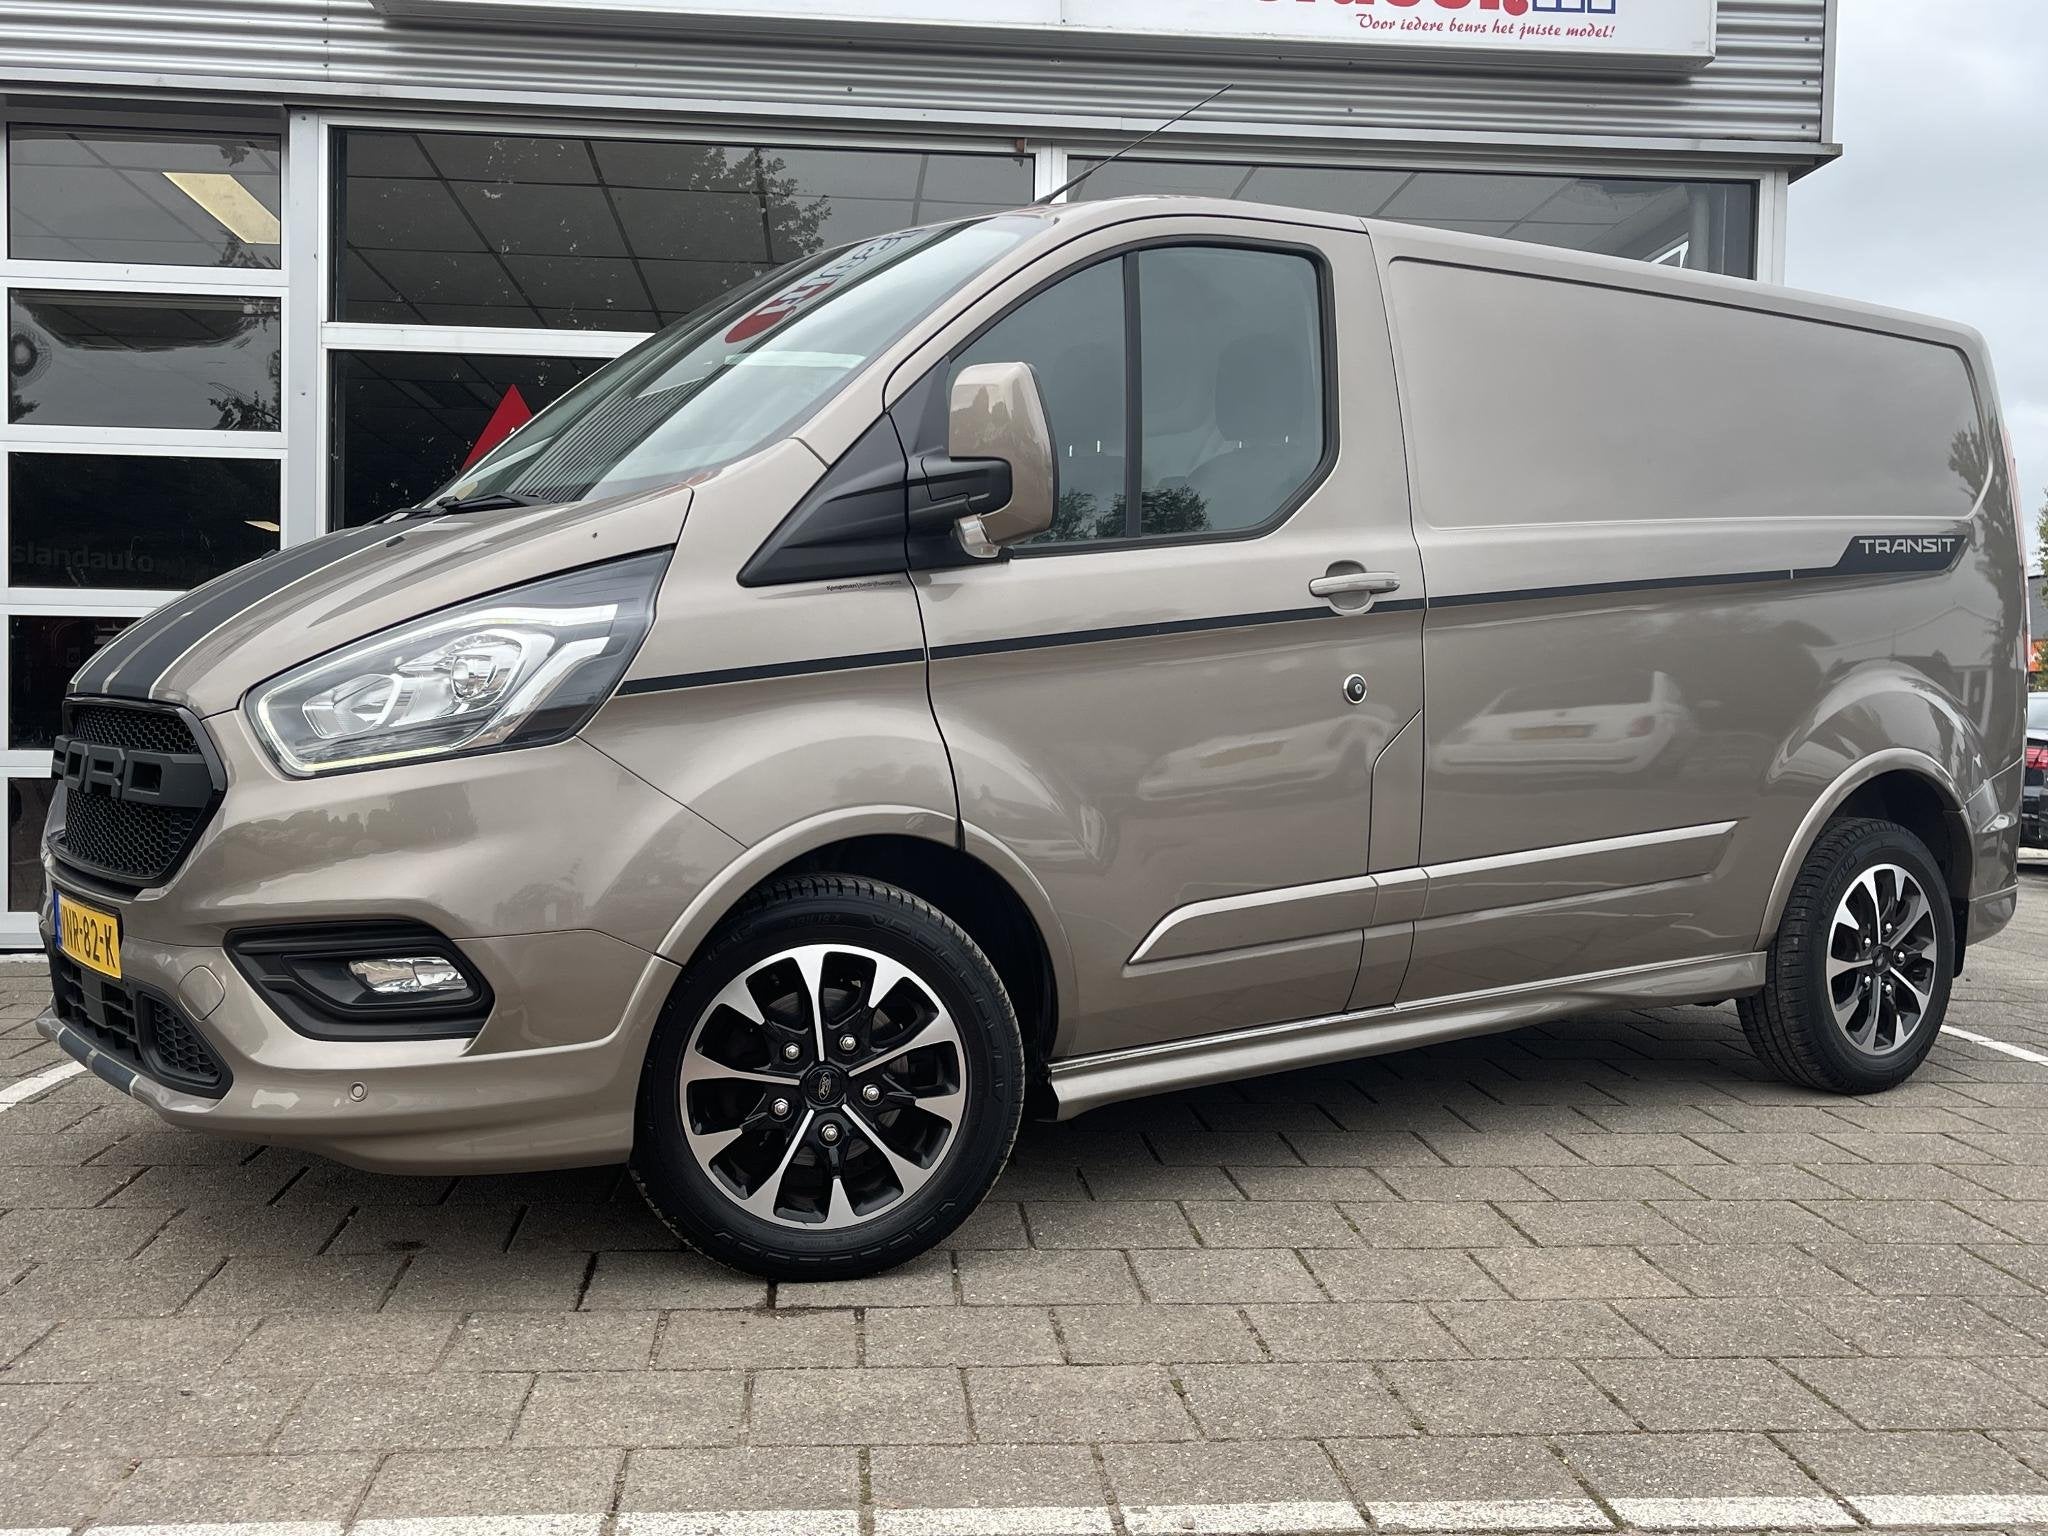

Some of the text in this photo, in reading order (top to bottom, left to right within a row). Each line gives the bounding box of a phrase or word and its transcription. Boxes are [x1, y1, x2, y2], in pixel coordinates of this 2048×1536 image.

[1356, 13, 1616, 39] Voor iedere beurs het juiste model!
[1859, 538, 1955, 554] TRANSIT
